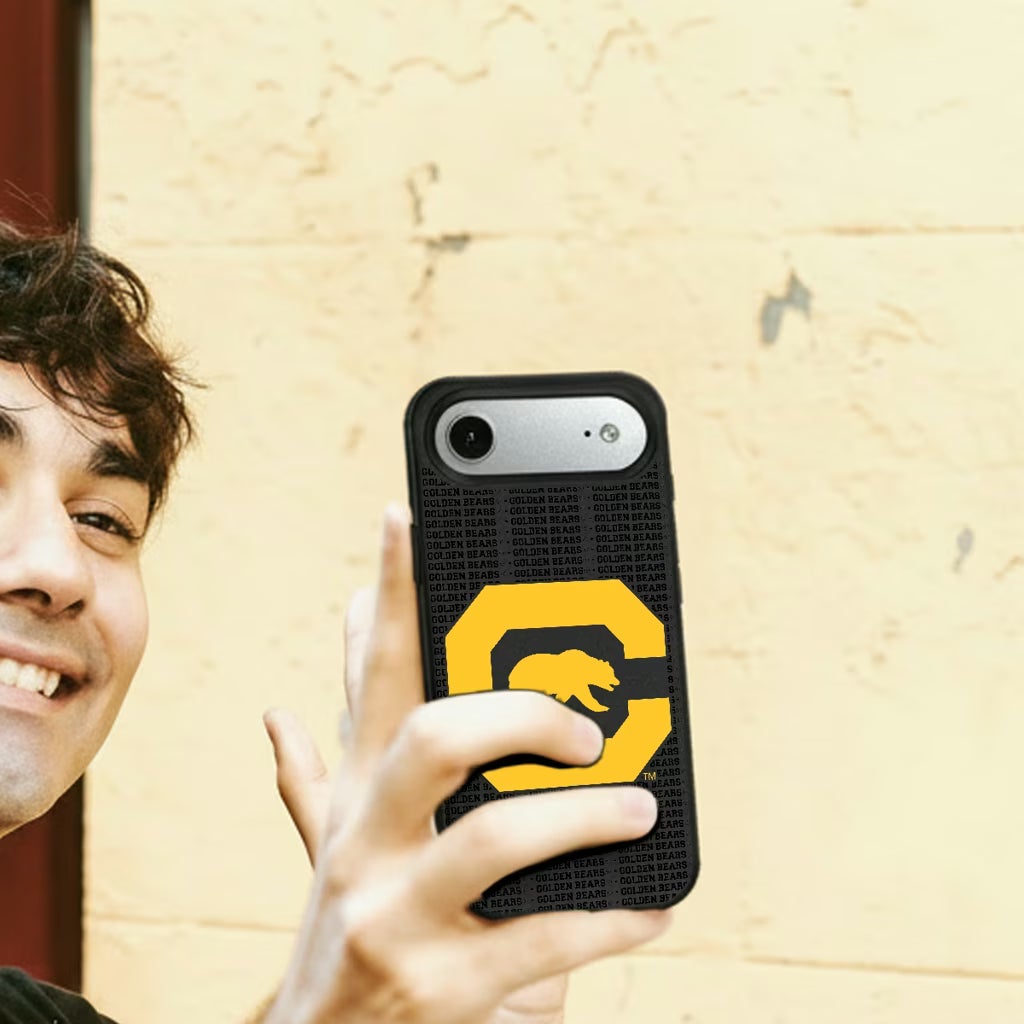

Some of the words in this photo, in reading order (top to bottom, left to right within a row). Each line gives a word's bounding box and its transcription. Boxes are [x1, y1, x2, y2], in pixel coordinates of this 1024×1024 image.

[423, 488, 460, 497] GOLDEN
[423, 498, 461, 508] GOLDEN
[463, 497, 495, 506] BEARS
[509, 496, 546, 505] GOLDEN
[547, 494, 579, 503] BEARS
[592, 493, 628, 502] GOLDEN
[630, 492, 660, 500] BEARS
[424, 509, 461, 518] GOLDEN
[464, 508, 495, 517] BEARS
[510, 506, 546, 515] GOLDEN
[548, 505, 579, 513] BEARS
[593, 503, 628, 512] GOLDEN
[631, 502, 661, 511] BEARS
[425, 519, 462, 529] GOLDEN
[465, 518, 496, 527] BEARS
[510, 516, 547, 525] GOLDEN
[549, 515, 580, 524] BEARS
[594, 513, 629, 522] GOLDEN
[632, 512, 662, 521] BEARS
[426, 530, 463, 539] GOLDEN
[465, 528, 497, 538] BEARS
[511, 527, 548, 536] GOLDEN
[549, 525, 581, 534] BEARS
[595, 524, 630, 533] GOLDEN
[632, 522, 663, 531] BEARS
[426, 540, 464, 550] GOLDEN
[466, 539, 498, 548] BEARS
[512, 537, 548, 546] GOLDEN
[550, 536, 581, 545] BEARS
[595, 534, 631, 543] GOLDEN
[633, 532, 663, 541] BEARS
[427, 551, 464, 560] GOLDEN
[467, 549, 498, 559] BEARS
[513, 547, 549, 557] GOLDEN
[551, 546, 582, 555] BEARS
[596, 544, 631, 553] GOLDEN
[634, 543, 664, 551] BEARS
[428, 561, 465, 571] GOLDEN
[468, 560, 499, 569] BEARS
[513, 558, 550, 567] GOLDEN
[552, 556, 583, 565] BEARS
[597, 554, 632, 563] GOLDEN
[635, 553, 665, 562] BEARS
[429, 572, 466, 581] GOLDEN
[468, 570, 500, 580] BEARS
[514, 568, 551, 577] GOLDEN
[552, 566, 584, 576] BEARS
[598, 564, 633, 574] GOLDEN
[635, 563, 666, 572] BEARS
[430, 582, 467, 592] GOLDEN
[636, 573, 666, 582] BEARS
[637, 583, 667, 592] BEARS
[641, 593, 668, 602] EARS
[643, 772, 657, 781] TM
[657, 768, 680, 777] EARS
[659, 799, 682, 808] EARS
[659, 809, 683, 819] EARS
[660, 819, 684, 829] EARS
[655, 840, 685, 850] BEARS
[618, 854, 653, 864] GOLDEN
[656, 850, 686, 861] BEARS
[574, 868, 605, 879] BEARS
[619, 864, 654, 875] GOLDEN
[657, 861, 687, 871] BEARS
[537, 882, 573, 893] GOLDEN
[575, 879, 606, 889] BEARS
[620, 874, 655, 885] GOLDEN
[658, 871, 688, 882] BEARS
[537, 892, 574, 904] GOLDEN
[576, 889, 607, 900] BEARS
[621, 885, 656, 896] GOLDEN
[621, 895, 656, 906] GOLDEN
